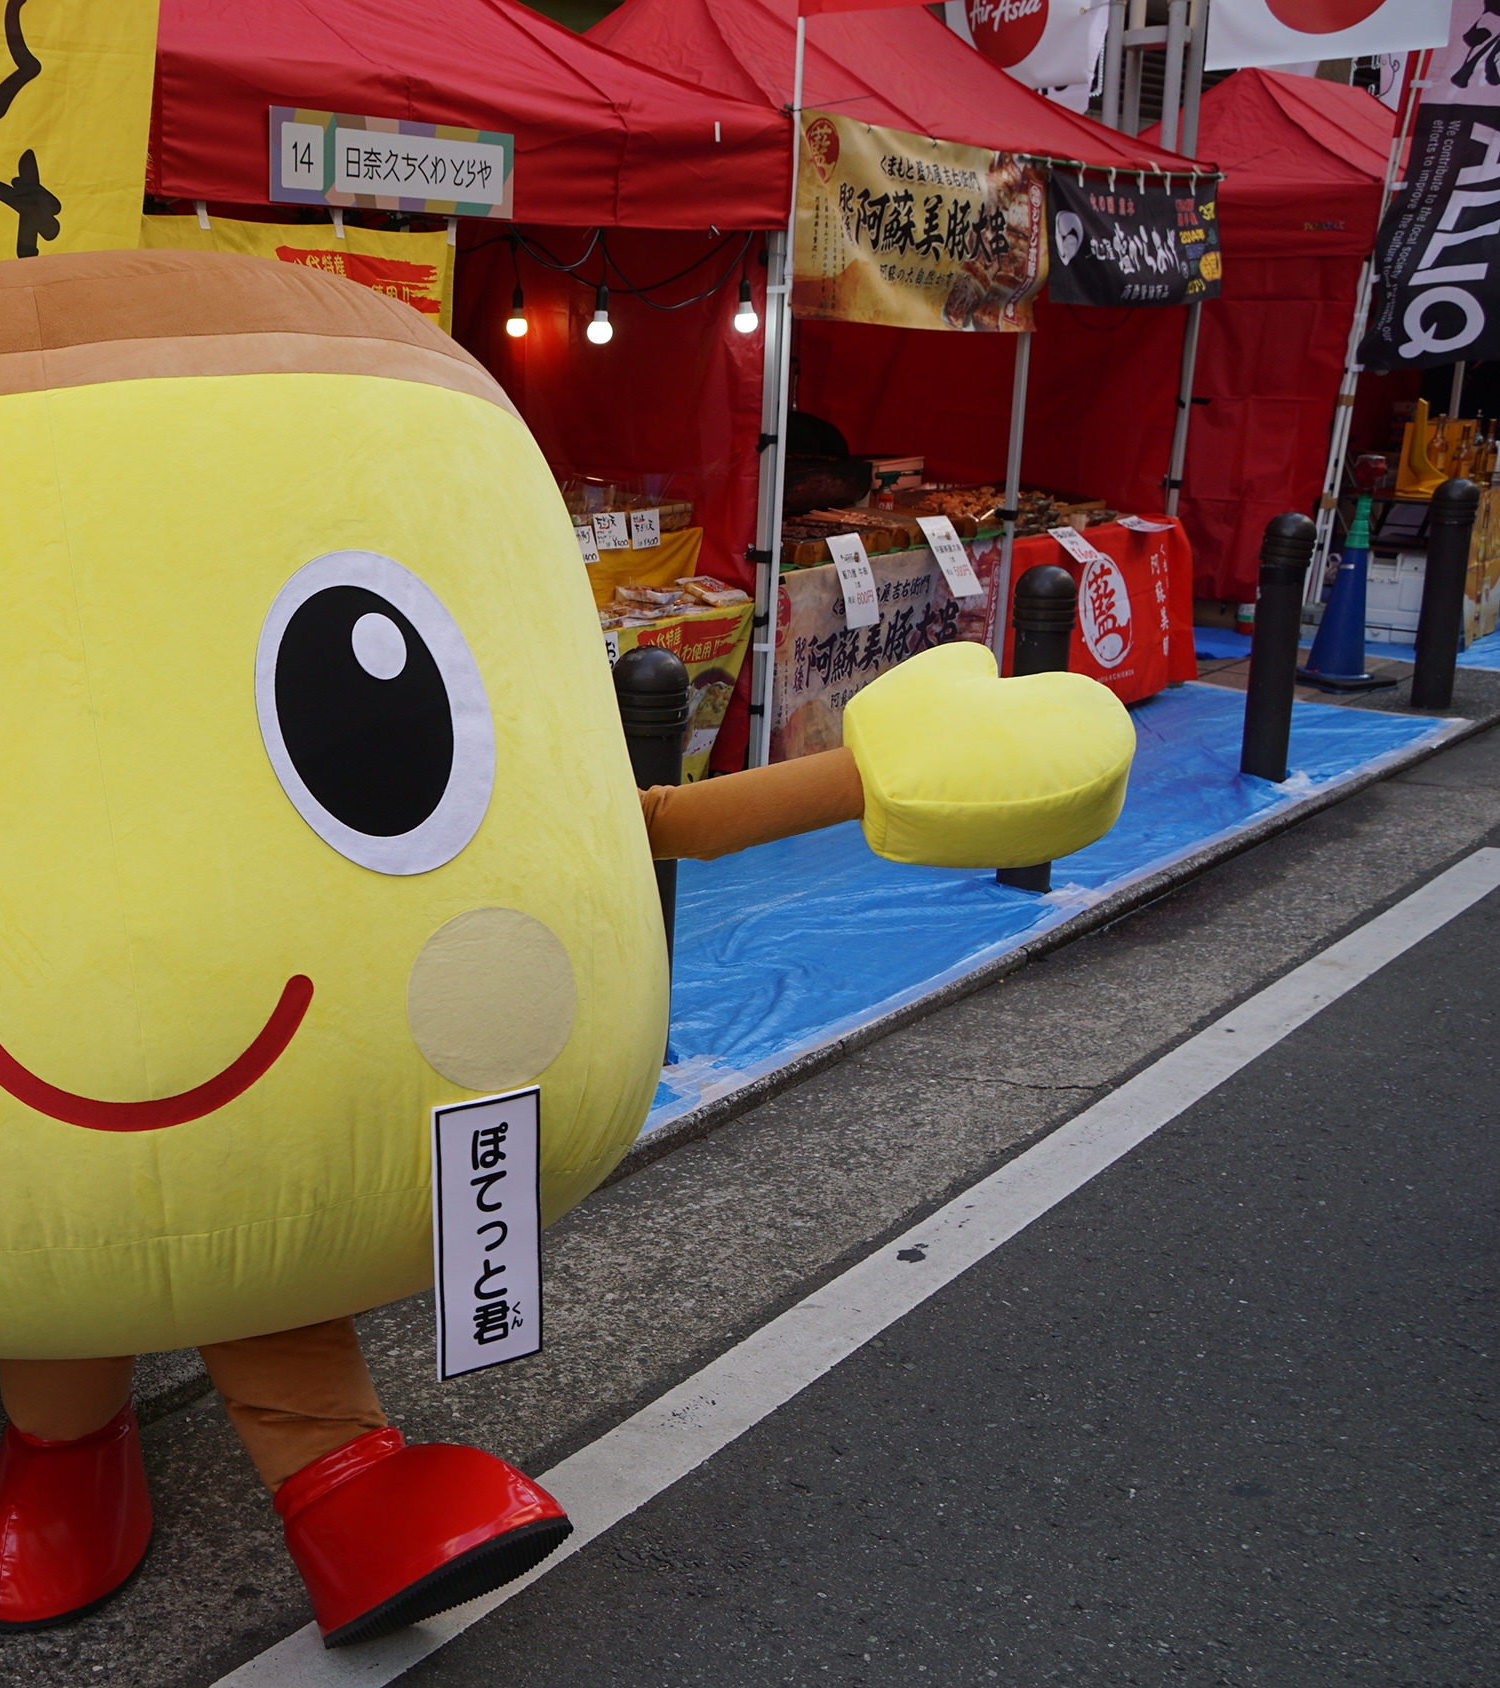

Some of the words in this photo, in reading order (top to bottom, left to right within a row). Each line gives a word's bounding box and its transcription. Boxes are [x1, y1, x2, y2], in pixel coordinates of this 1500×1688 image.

[1426, 119, 1445, 153] efforts
[1446, 120, 1462, 136] We
[291, 141, 314, 173] 14
[1423, 155, 1436, 167] to
[1430, 138, 1454, 192] contribute
[1407, 169, 1433, 209] improve
[1424, 194, 1438, 204] to
[1398, 213, 1414, 229] the
[1416, 206, 1432, 222] the
[1384, 230, 1404, 263] culture
[1406, 223, 1426, 245] local
[471, 1121, 510, 1345] ぽてっと君
[511, 1301, 523, 1329] くん
